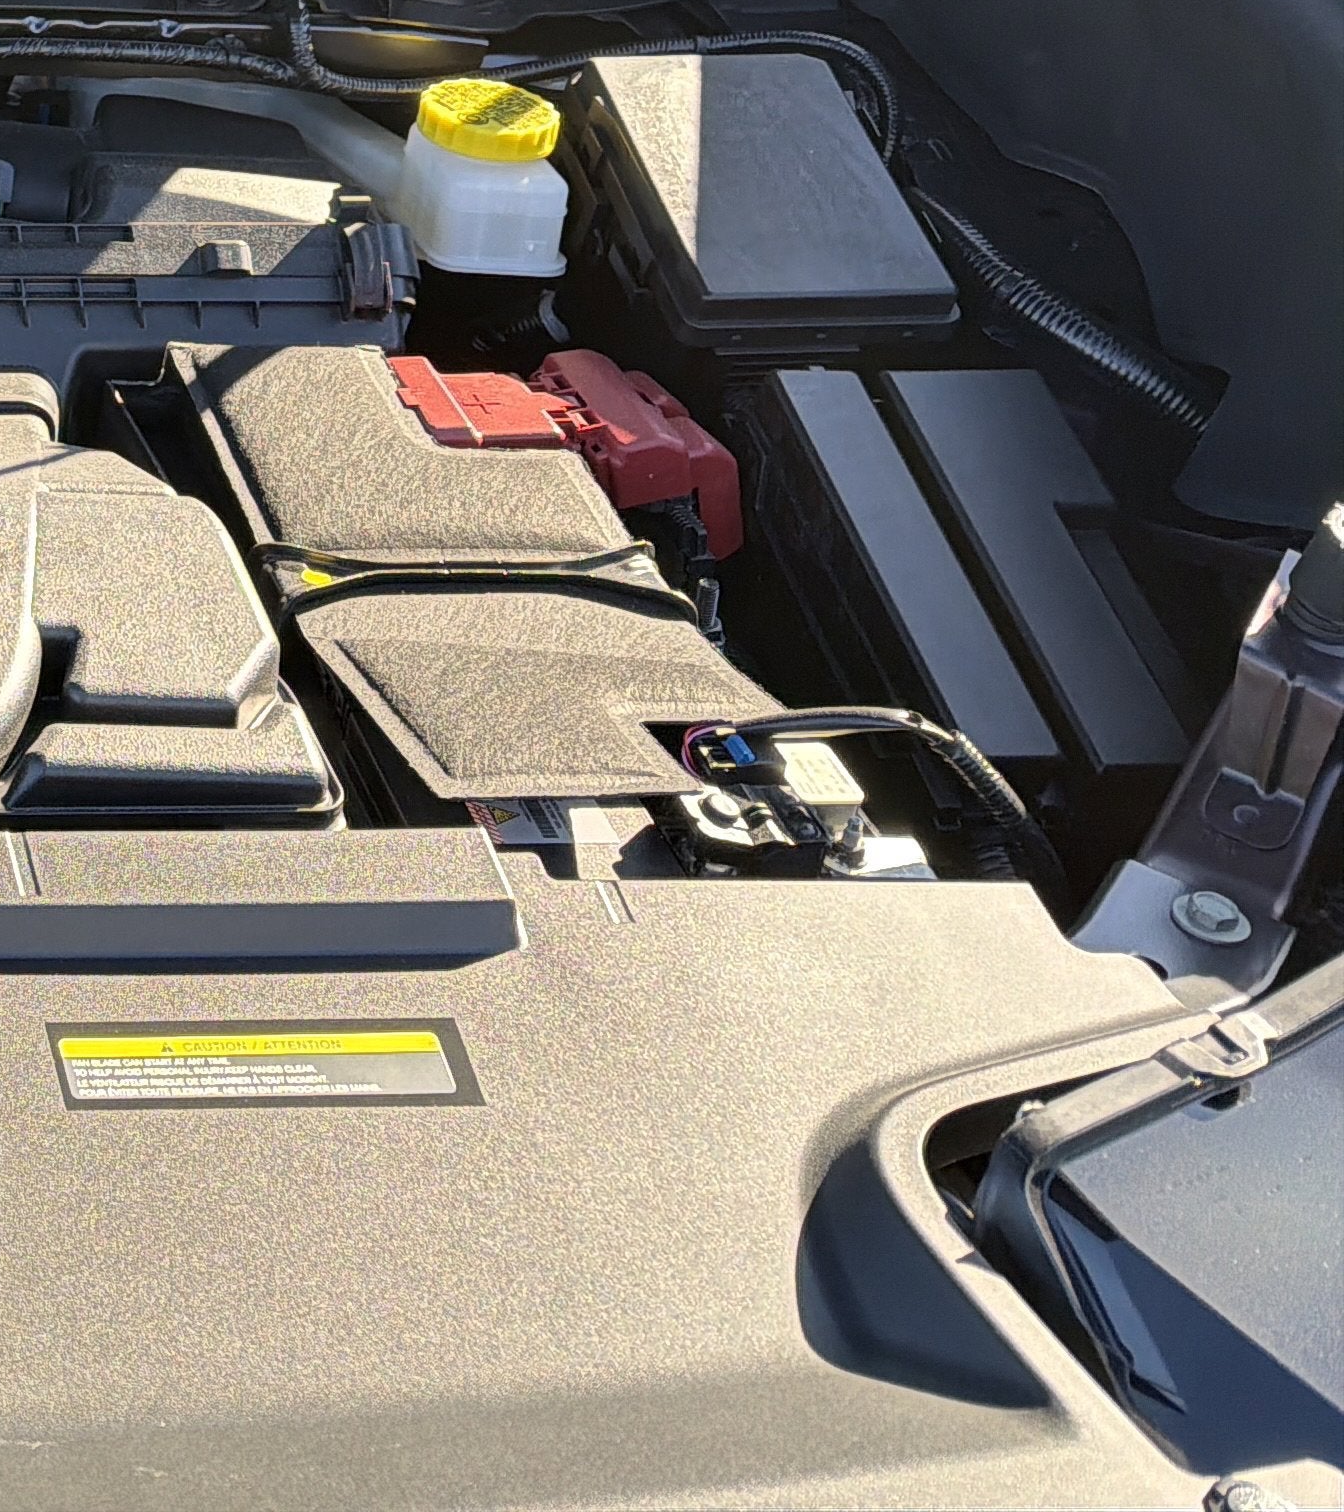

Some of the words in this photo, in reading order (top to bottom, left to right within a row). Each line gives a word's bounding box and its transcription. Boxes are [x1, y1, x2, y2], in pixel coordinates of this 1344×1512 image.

[182, 1040, 248, 1052] CAUTION
[263, 1039, 342, 1050] ATTENTION
[73, 1068, 88, 1077] TO
